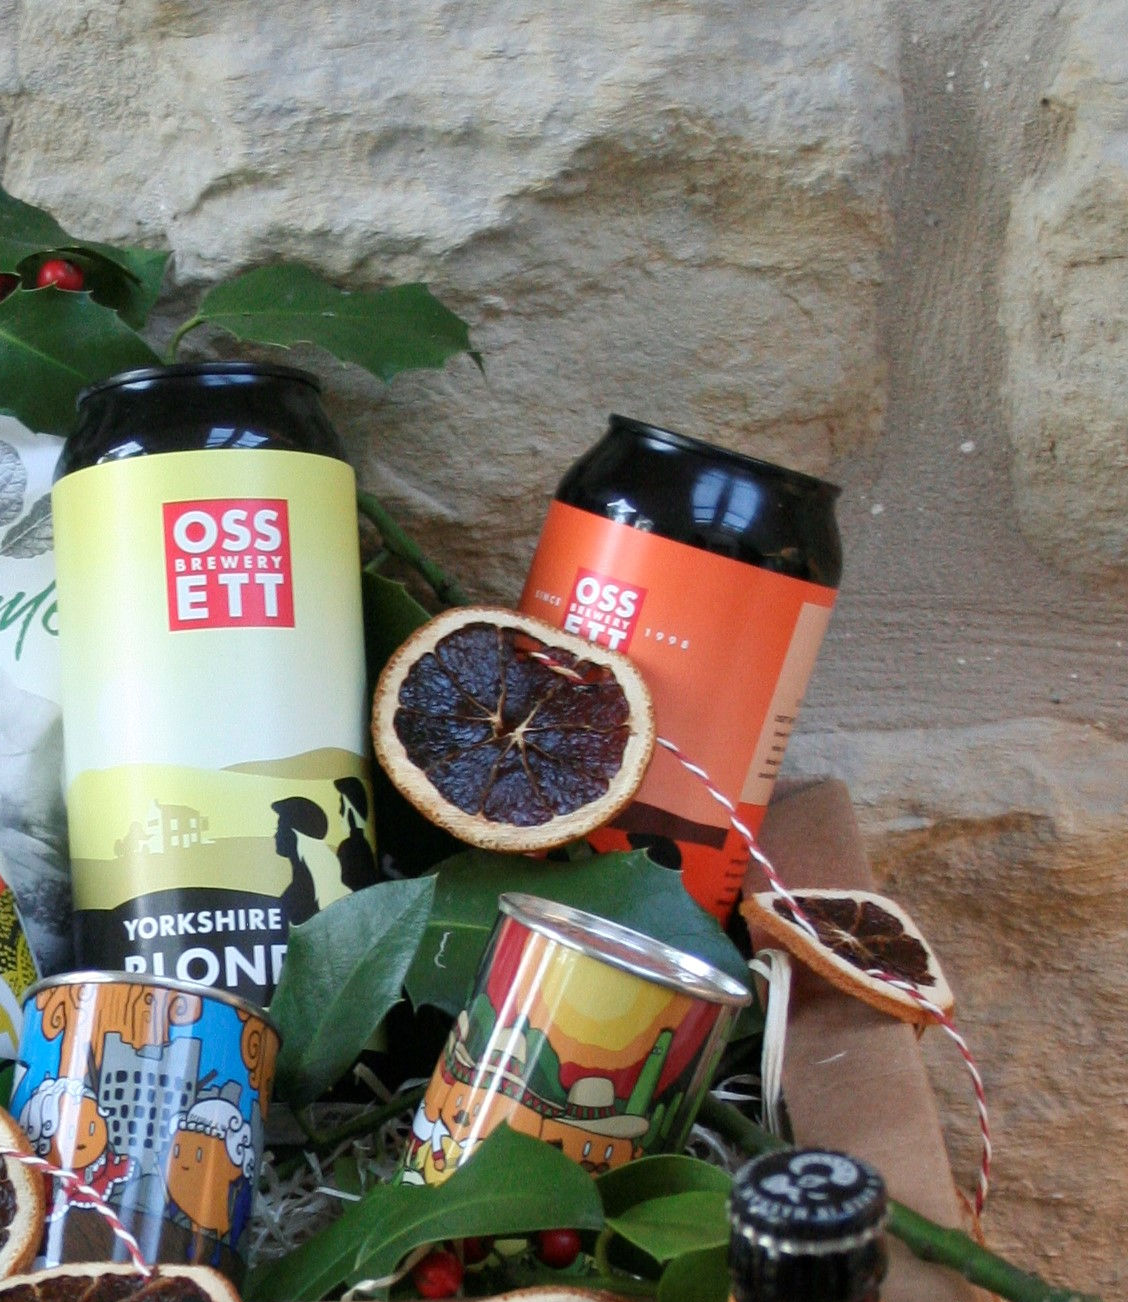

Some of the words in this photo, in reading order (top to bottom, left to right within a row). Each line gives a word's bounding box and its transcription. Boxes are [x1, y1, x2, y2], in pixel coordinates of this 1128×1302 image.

[173, 509, 282, 555] OSS
[174, 556, 283, 571] BREWERY
[176, 573, 284, 622] ETT
[569, 602, 631, 631] BREWERY
[575, 576, 639, 619] OSS
[564, 613, 628, 651] ETT
[123, 908, 283, 941] YORKSHIRE
[124, 944, 289, 988] BLON
